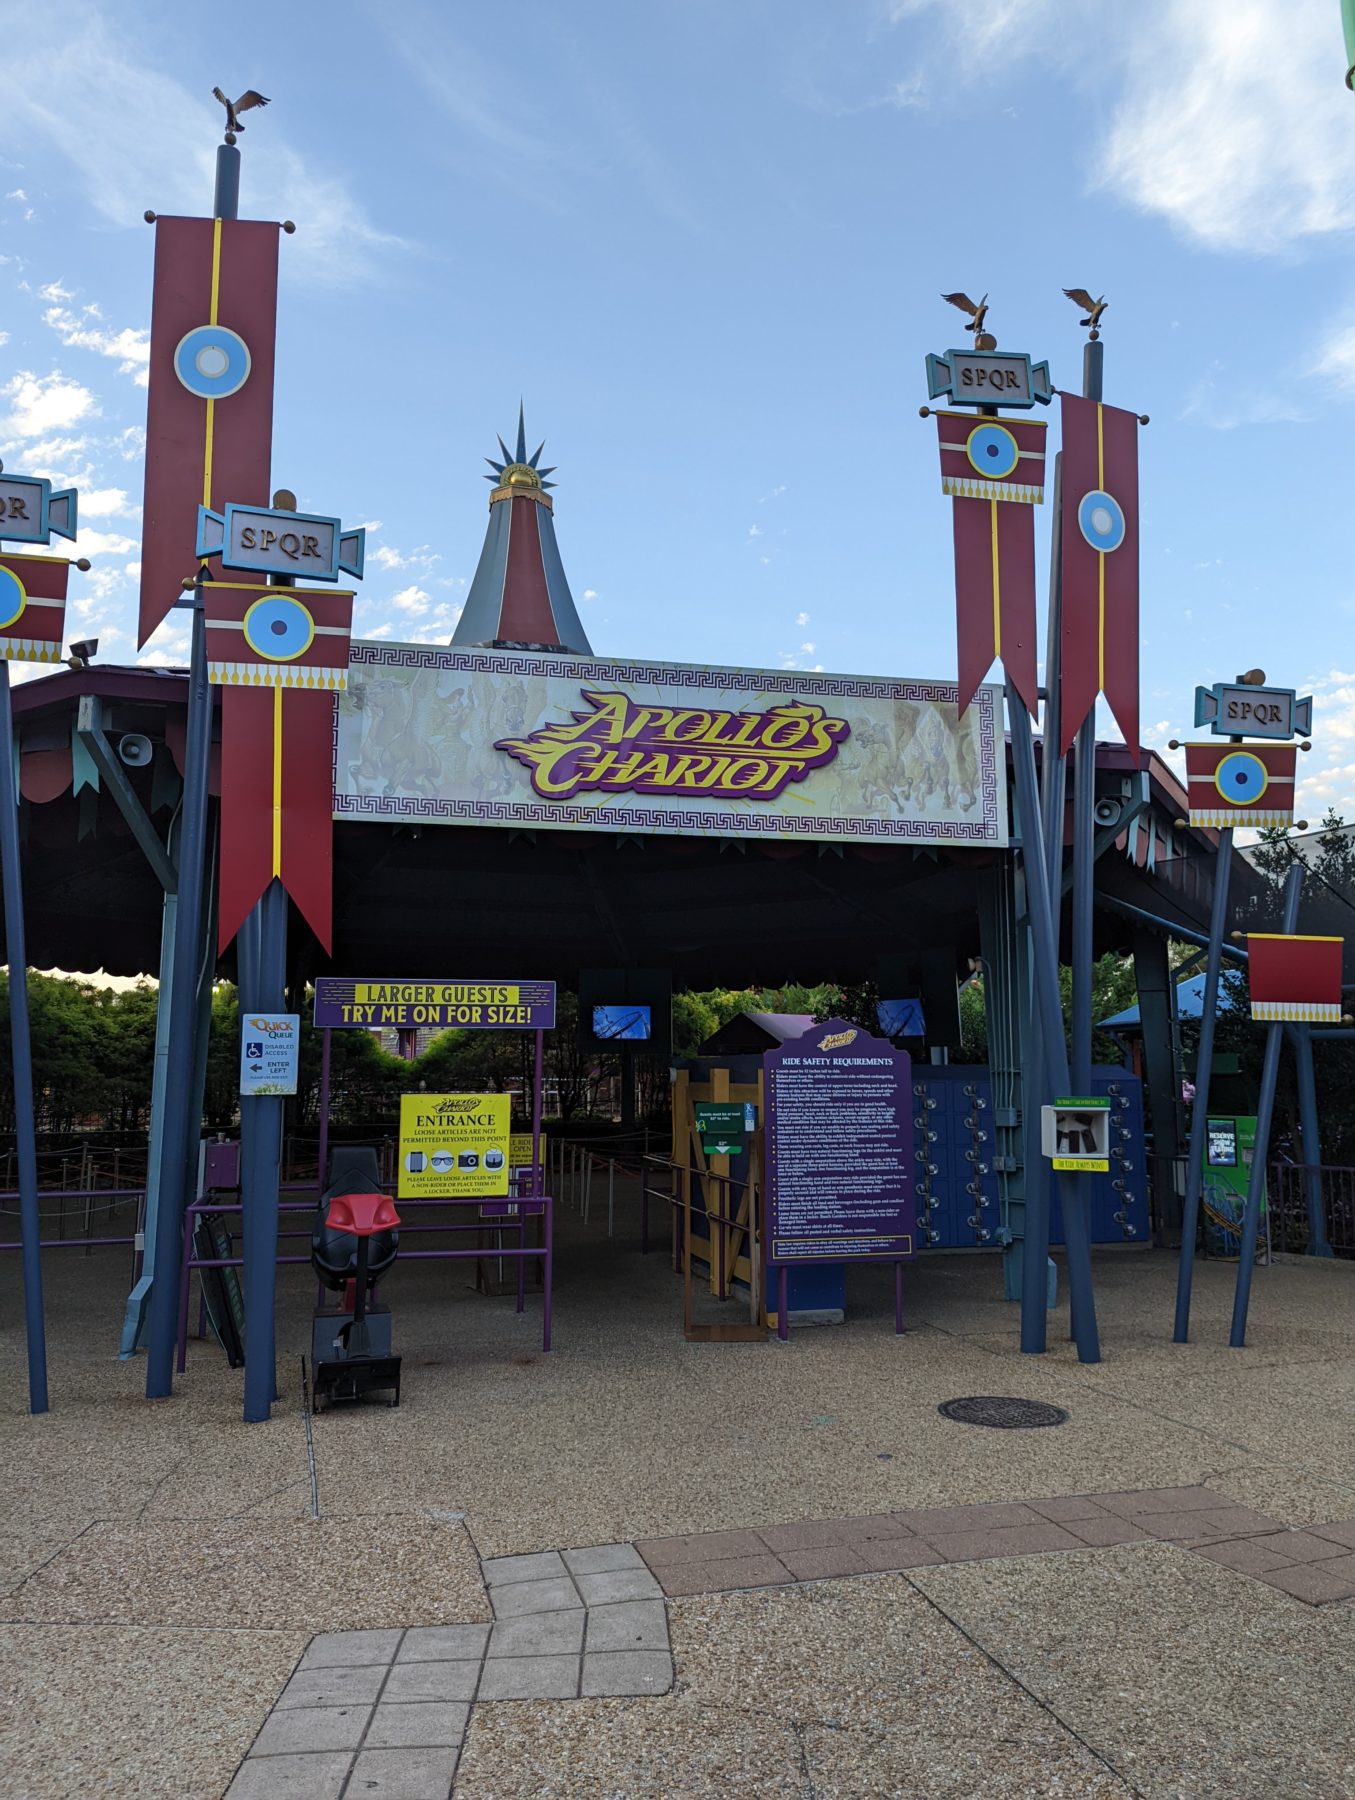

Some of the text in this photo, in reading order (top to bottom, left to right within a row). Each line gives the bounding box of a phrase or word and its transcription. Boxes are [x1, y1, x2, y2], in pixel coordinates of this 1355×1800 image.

[962, 367, 1021, 391] SPQR
[241, 527, 322, 560] SPQR
[1228, 701, 1282, 725] SPQR
[530, 690, 846, 758] APOLLO'S
[498, 741, 806, 793] CHARIOT
[367, 985, 509, 1004] LARGER GUESTS
[341, 1005, 533, 1024] TRY ME ON FOR SIZE!
[268, 1031, 294, 1040] QUEUE
[782, 1058, 894, 1067] RIDE SAFETY REQUIREMENTS
[416, 1115, 496, 1127] ENTRANCE
